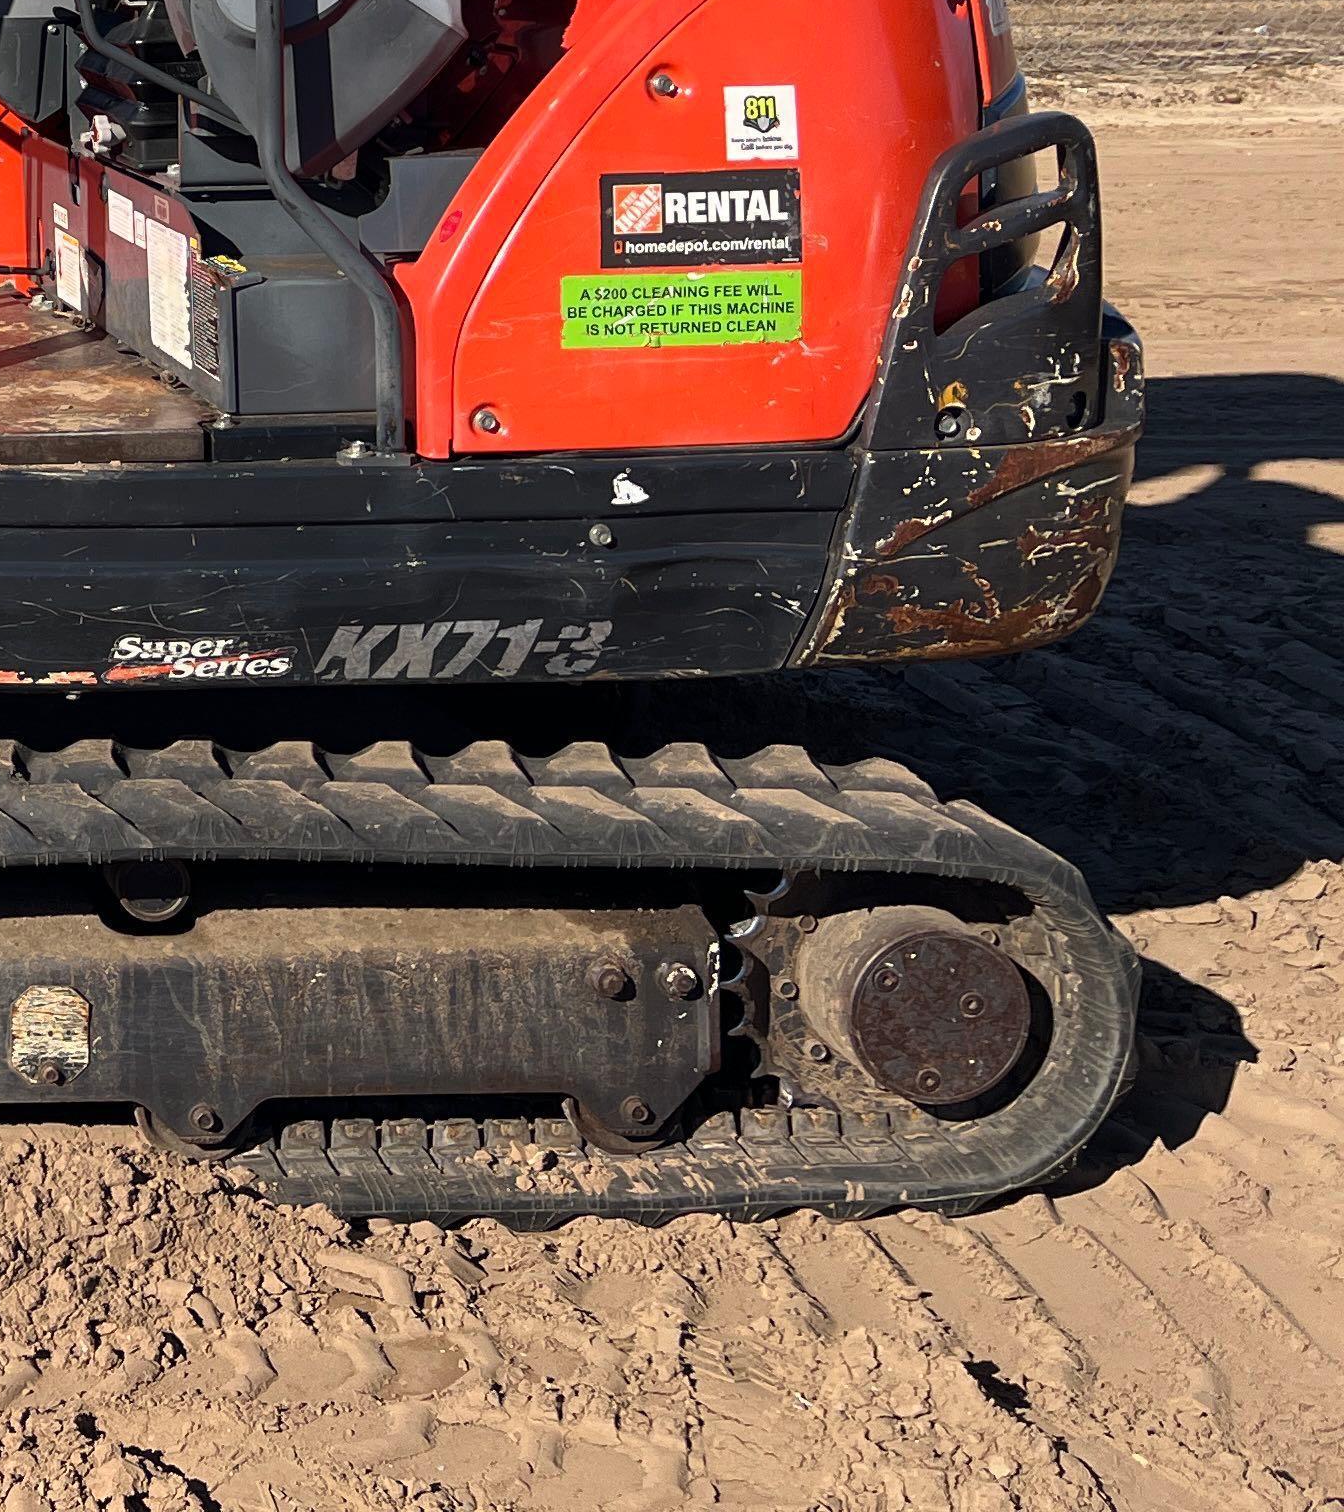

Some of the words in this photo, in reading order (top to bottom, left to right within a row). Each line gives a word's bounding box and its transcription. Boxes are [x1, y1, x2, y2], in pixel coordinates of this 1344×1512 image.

[744, 96, 776, 120] 811
[615, 184, 661, 232] HOME
[665, 189, 788, 224] RENTAL
[625, 236, 789, 255] homedepot.com/rental
[580, 289, 590, 300] A
[594, 287, 627, 301] $200
[632, 285, 709, 299] CLEANING
[714, 285, 743, 297] FEE
[747, 284, 782, 297] WILL
[567, 307, 587, 318] BE
[592, 305, 666, 318] CHARGED
[671, 304, 685, 316] IF
[689, 303, 722, 315] THIS
[726, 301, 794, 315] MACHINE
[586, 324, 599, 335] IS
[604, 323, 635, 335] NOT
[640, 321, 722, 335] RETURNED
[726, 320, 776, 332] CLEAN
[114, 636, 234, 663] Super
[313, 618, 613, 679] KX71-3
[169, 653, 289, 679] Series
